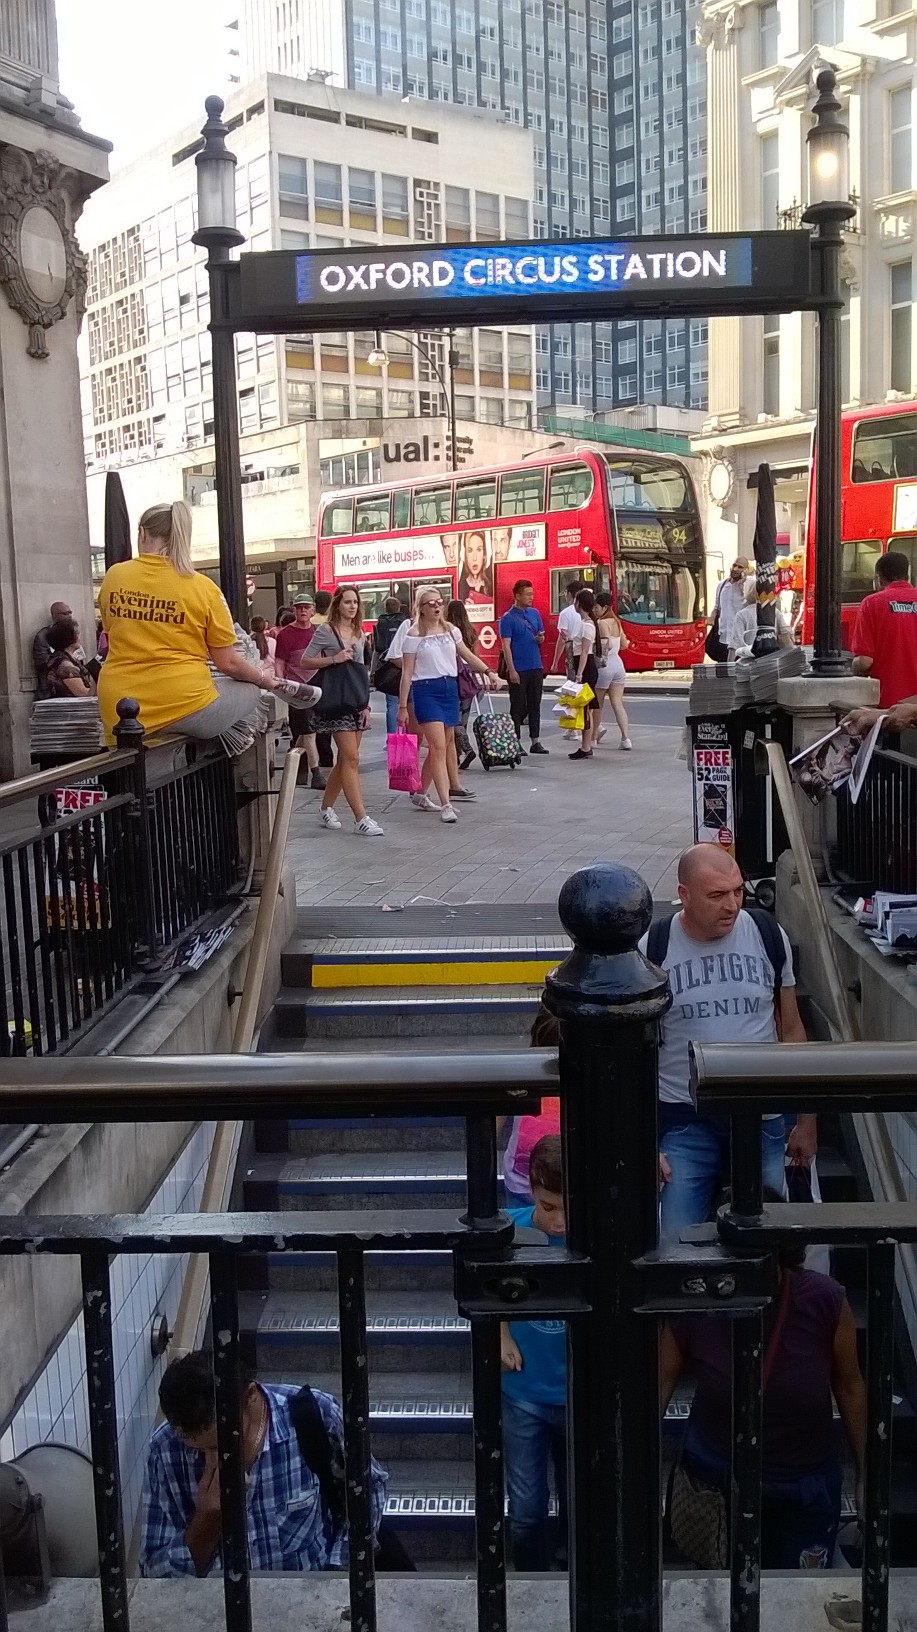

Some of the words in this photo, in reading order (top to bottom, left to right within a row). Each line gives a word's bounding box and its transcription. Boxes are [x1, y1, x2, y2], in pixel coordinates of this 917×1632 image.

[320, 261, 455, 292] OXFORD
[463, 255, 579, 286] CIRCUS
[587, 250, 727, 282] STATION
[557, 528, 581, 536] LONDON
[557, 535, 581, 543] UNITED
[672, 527, 687, 544] 94
[341, 554, 360, 567] Men
[377, 550, 393, 564] like
[109, 591, 178, 613] Evening
[119, 588, 150, 599] London
[109, 605, 186, 624] Standard
[889, 600, 912, 613] Time
[696, 750, 730, 767] FREE
[697, 766, 711, 781] 52
[712, 766, 727, 774] PAGE
[667, 952, 775, 995] ILFIGER
[680, 997, 760, 1019] DENIM
